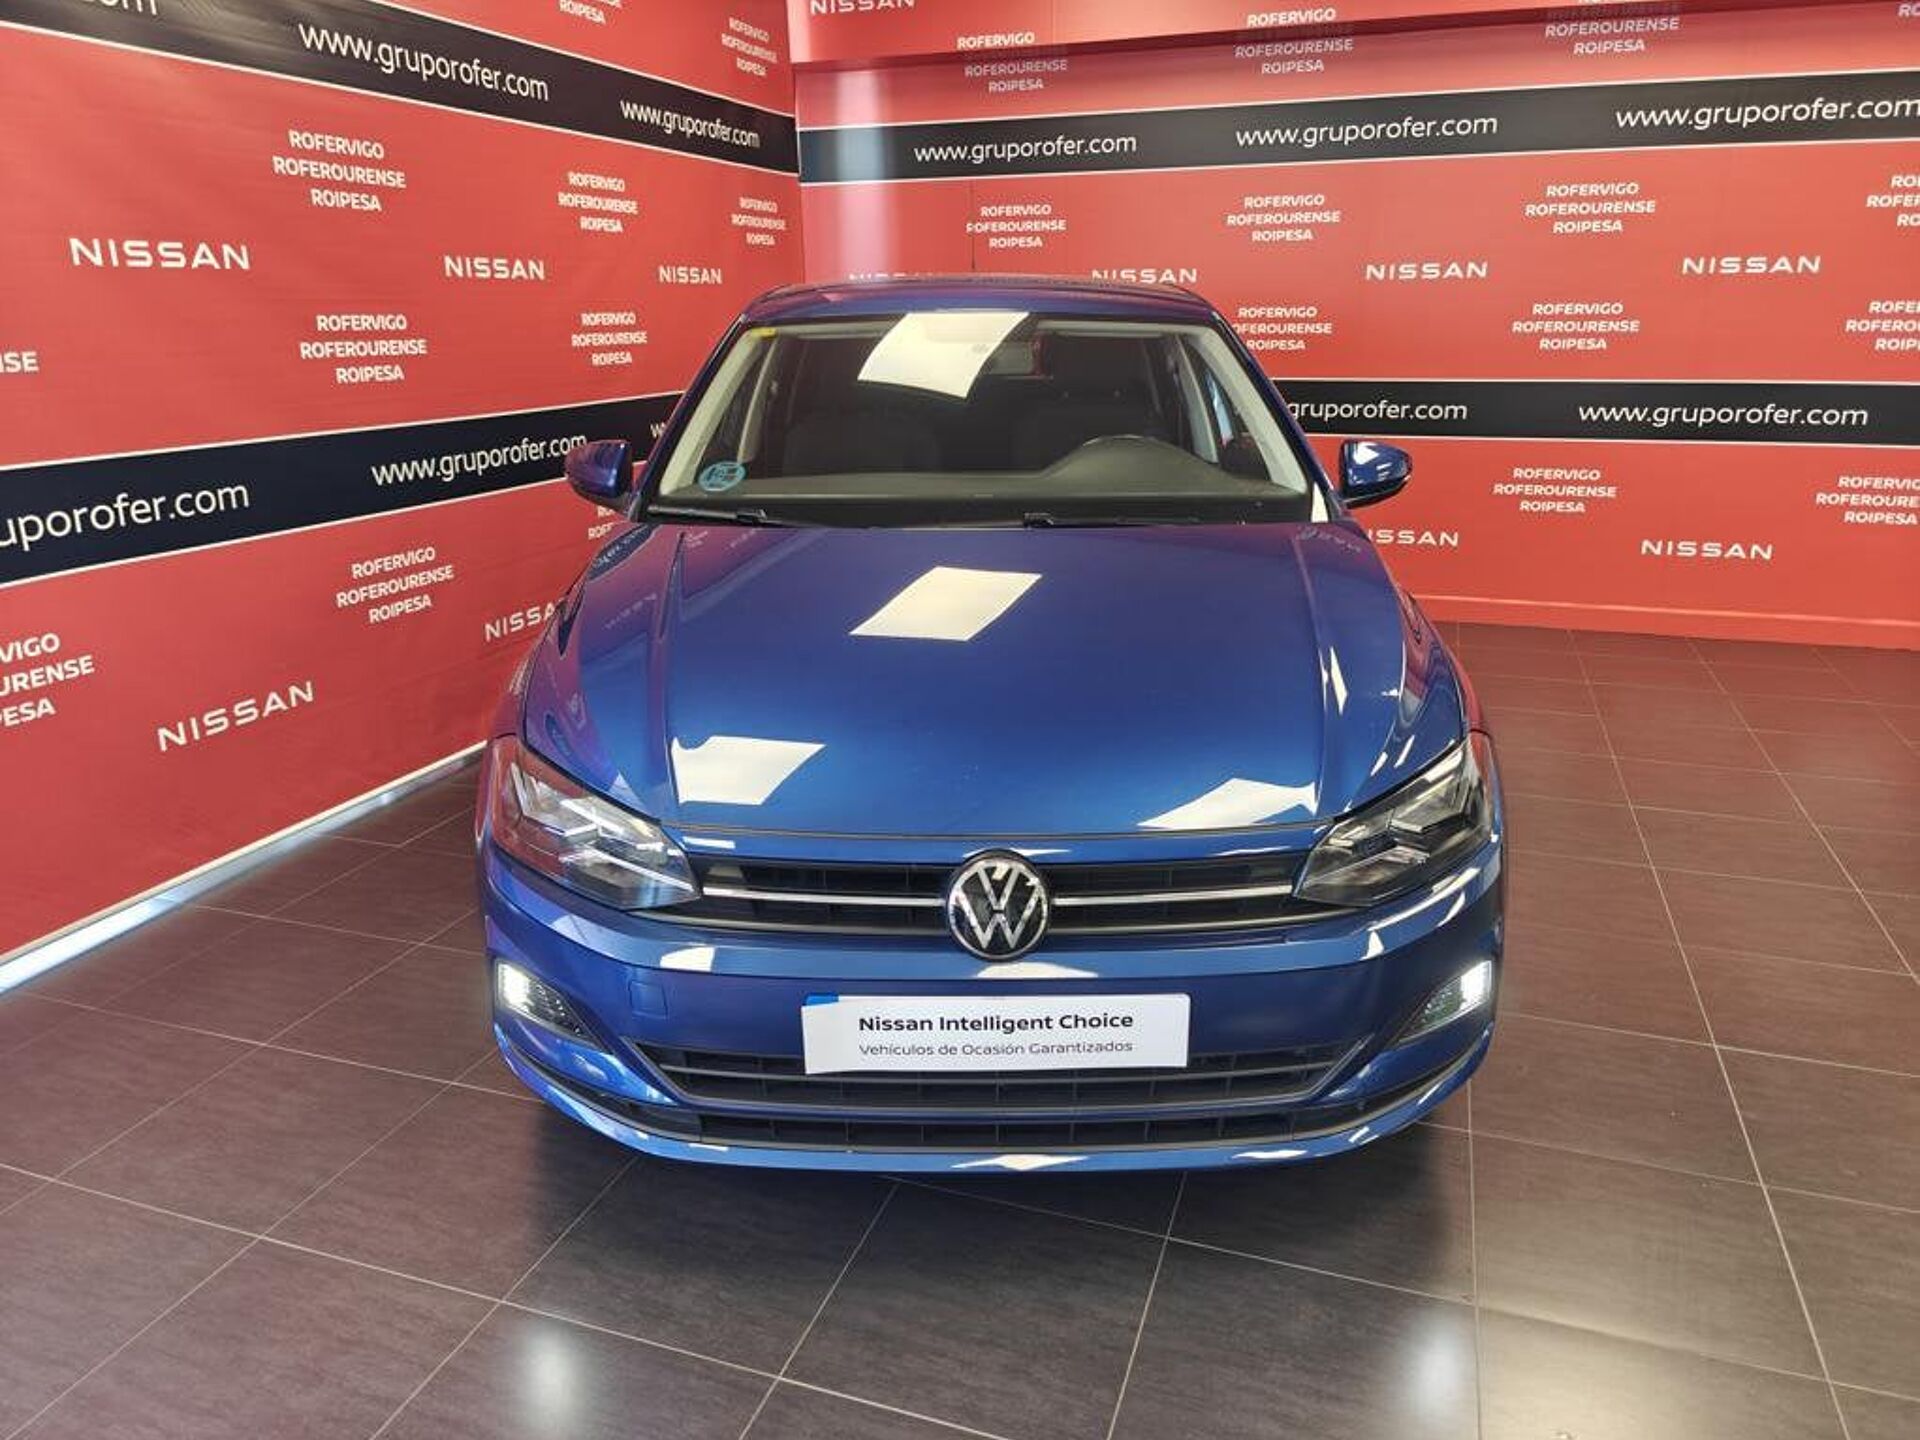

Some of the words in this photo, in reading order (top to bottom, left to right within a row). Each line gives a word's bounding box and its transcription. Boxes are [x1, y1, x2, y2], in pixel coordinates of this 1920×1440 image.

[1247, 8, 1336, 28] ROFERVIGO
[1545, 17, 1681, 38] ROFEROURENSE
[957, 31, 1035, 49] ROFERVIGO
[1234, 38, 1354, 58] ROFEROURENSE
[1573, 39, 1645, 55] ROIPESA
[299, 23, 549, 102] www.gruporofer.com
[964, 59, 1067, 77] ROFEROURENSE
[1261, 59, 1325, 75] ROIPESA
[988, 78, 1044, 94] ROIPESA
[1615, 97, 1920, 130] www.gruporofer.com
[620, 99, 760, 148] www.gruporofer.com
[1236, 116, 1498, 147] www.gruporofer.com
[288, 129, 384, 159] ROFERVIGO
[914, 134, 1137, 164] www.gruporofer.com
[272, 155, 406, 189] ROFEROURENSE
[568, 171, 625, 193] ROFERVIGO
[1546, 182, 1640, 198] ROFERVIGO
[310, 188, 382, 212] ROIPESA
[558, 192, 638, 215] ROFEROURENSE
[1243, 194, 1325, 209] ROFERVIGO
[1525, 200, 1656, 217] ROFEROURENSE
[980, 203, 1052, 217] ROFERVIGO
[1226, 210, 1341, 227] ROFEROURENSE
[580, 216, 624, 234] ROIPESA
[1553, 219, 1623, 234] ROIPESA
[988, 236, 1043, 248] ROIPESA
[1251, 229, 1313, 242] ROIPESA
[69, 238, 250, 271] NISSAN
[444, 255, 545, 281] NISSAN
[1365, 261, 1488, 281] NISSAN
[1682, 255, 1821, 275] NISSAN
[658, 265, 722, 286] NISSAN
[1091, 267, 1198, 284] NISSAN
[1238, 307, 1318, 319] ROFERVIGO
[1532, 301, 1624, 316] ROFERVIGO
[316, 313, 408, 332] ROFERVIGO
[581, 312, 636, 327] ROFERVIGO
[1232, 322, 1333, 334] OFEROURENSE
[1512, 319, 1641, 334] ROFEROURENSE
[1844, 319, 1920, 332] ROFERO
[570, 331, 648, 347] ROFEROURENSE
[1246, 339, 1306, 350] ROIPESA
[1539, 338, 1607, 351] ROIPESA
[1874, 338, 1920, 351] ROIP
[299, 338, 428, 360] ROFEROURENSE
[591, 351, 633, 366] ROIPESA
[335, 365, 404, 384] ROIPESA
[1288, 399, 1467, 424] gruporofer.com
[1578, 404, 1868, 428] www.gruporofer.com
[371, 433, 587, 487] www.gruporofer.com
[1513, 468, 1601, 481] ROFERVIGO
[1493, 483, 1617, 498] ROFEROURENSE
[1519, 500, 1585, 513] ROIPESA
[1843, 511, 1918, 525] ROIPESA
[1367, 529, 1459, 547] ISSAN
[1641, 539, 1772, 560] NISSAN
[351, 546, 436, 580] ROFERVIGO
[336, 564, 455, 608] ROFEROURENSE
[369, 595, 433, 624] ROIPESA
[485, 599, 560, 642] NISSA
[0, 697, 56, 727] ESA
[157, 680, 315, 752] NISSAN
[858, 1016, 933, 1032] Nissan
[939, 1015, 1053, 1034] Intelligent
[1058, 1013, 1134, 1029] Choice
[858, 1043, 935, 1056] Vehículos
[938, 1043, 958, 1055] de
[962, 1042, 1024, 1055] Ocasión
[1028, 1041, 1134, 1055] Garantizados
